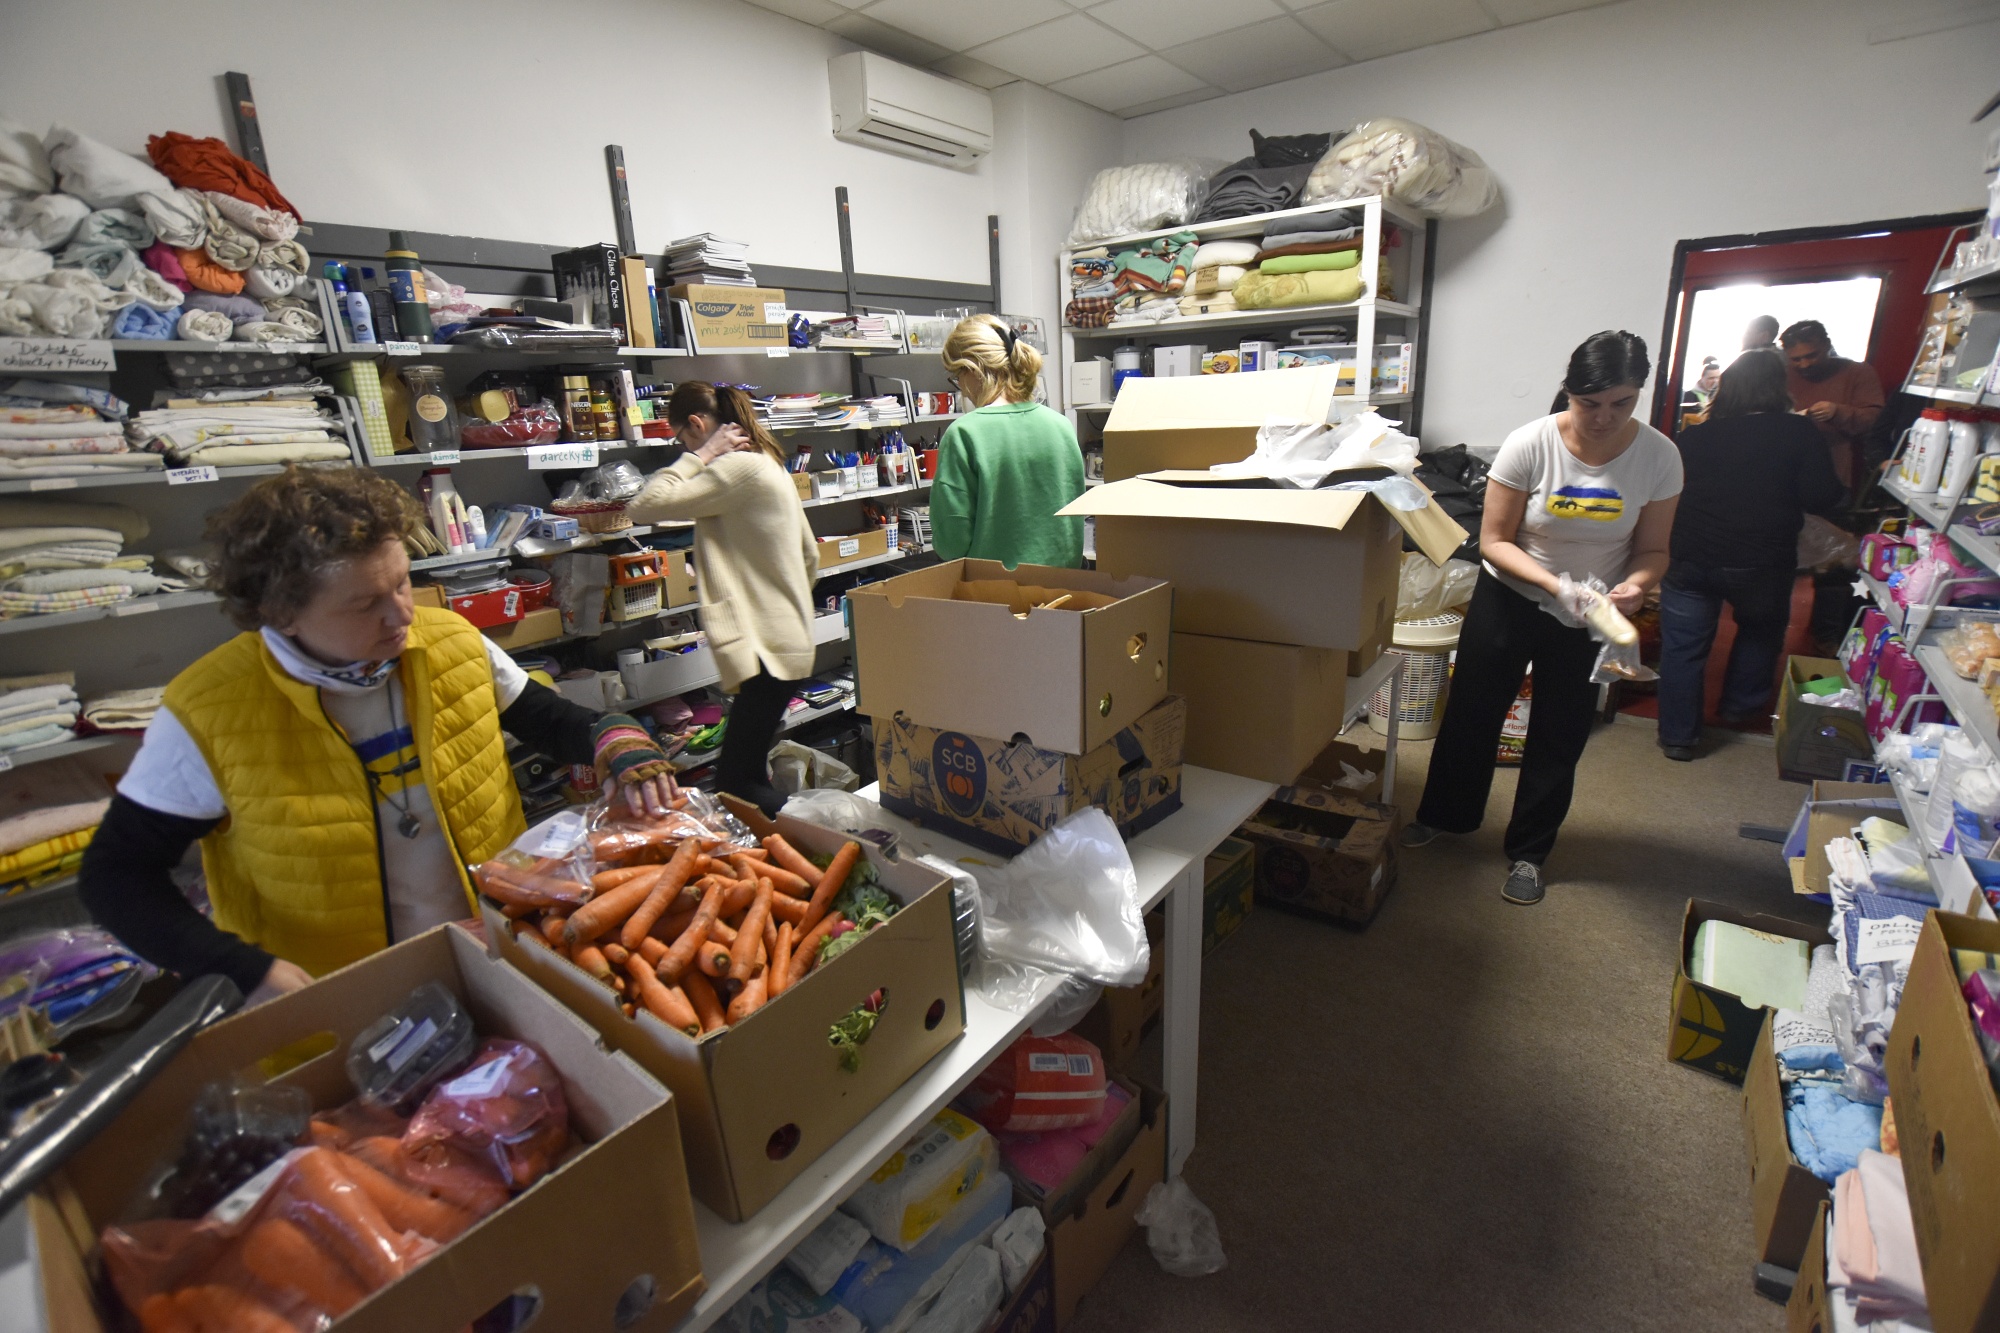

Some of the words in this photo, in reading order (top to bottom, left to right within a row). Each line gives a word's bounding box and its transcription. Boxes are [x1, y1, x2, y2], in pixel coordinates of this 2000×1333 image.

[606, 249, 617, 276] Glass
[610, 279, 620, 309] Chess
[697, 303, 730, 314] Colgate
[739, 303, 755, 312] Triple
[701, 327, 720, 337] mix
[942, 748, 977, 773] SCB
